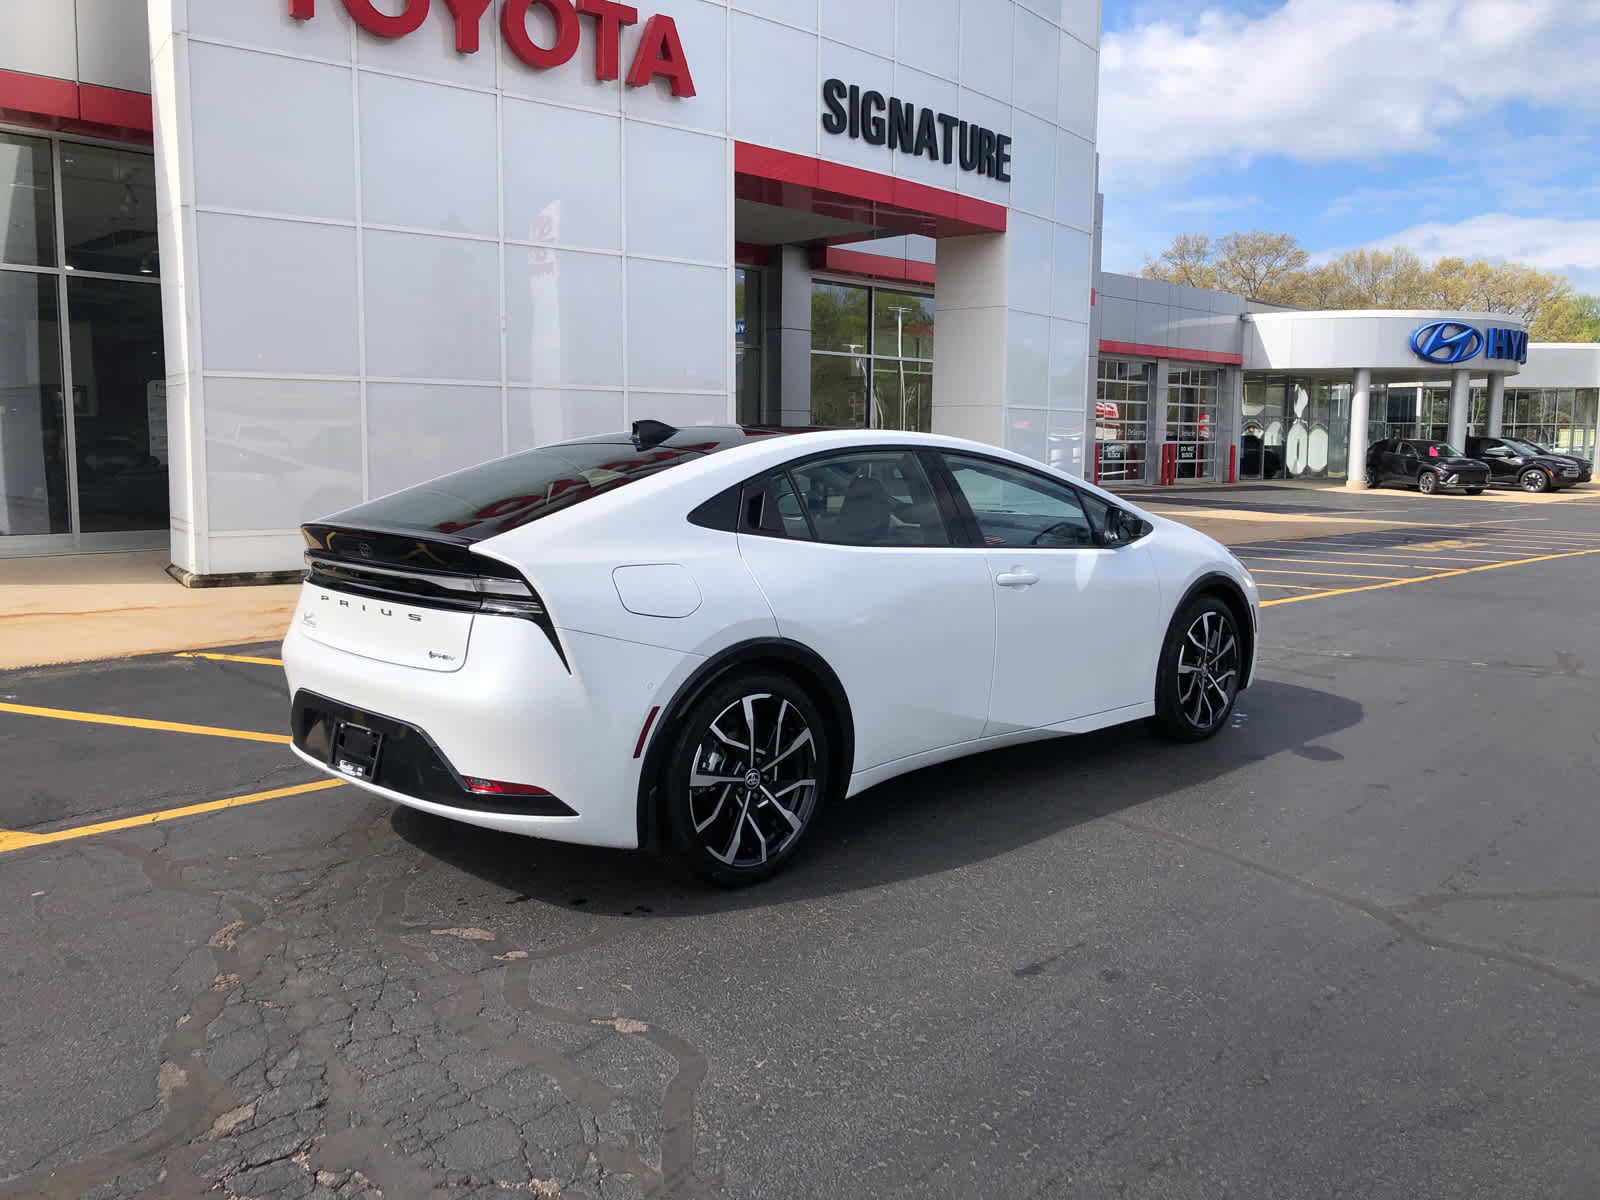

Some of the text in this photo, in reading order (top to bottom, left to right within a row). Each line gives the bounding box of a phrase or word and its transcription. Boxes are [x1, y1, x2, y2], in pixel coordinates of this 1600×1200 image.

[288, 0, 696, 98] YOTA
[822, 78, 1012, 183] SIGNATURE
[320, 595, 422, 622] PRIUS
